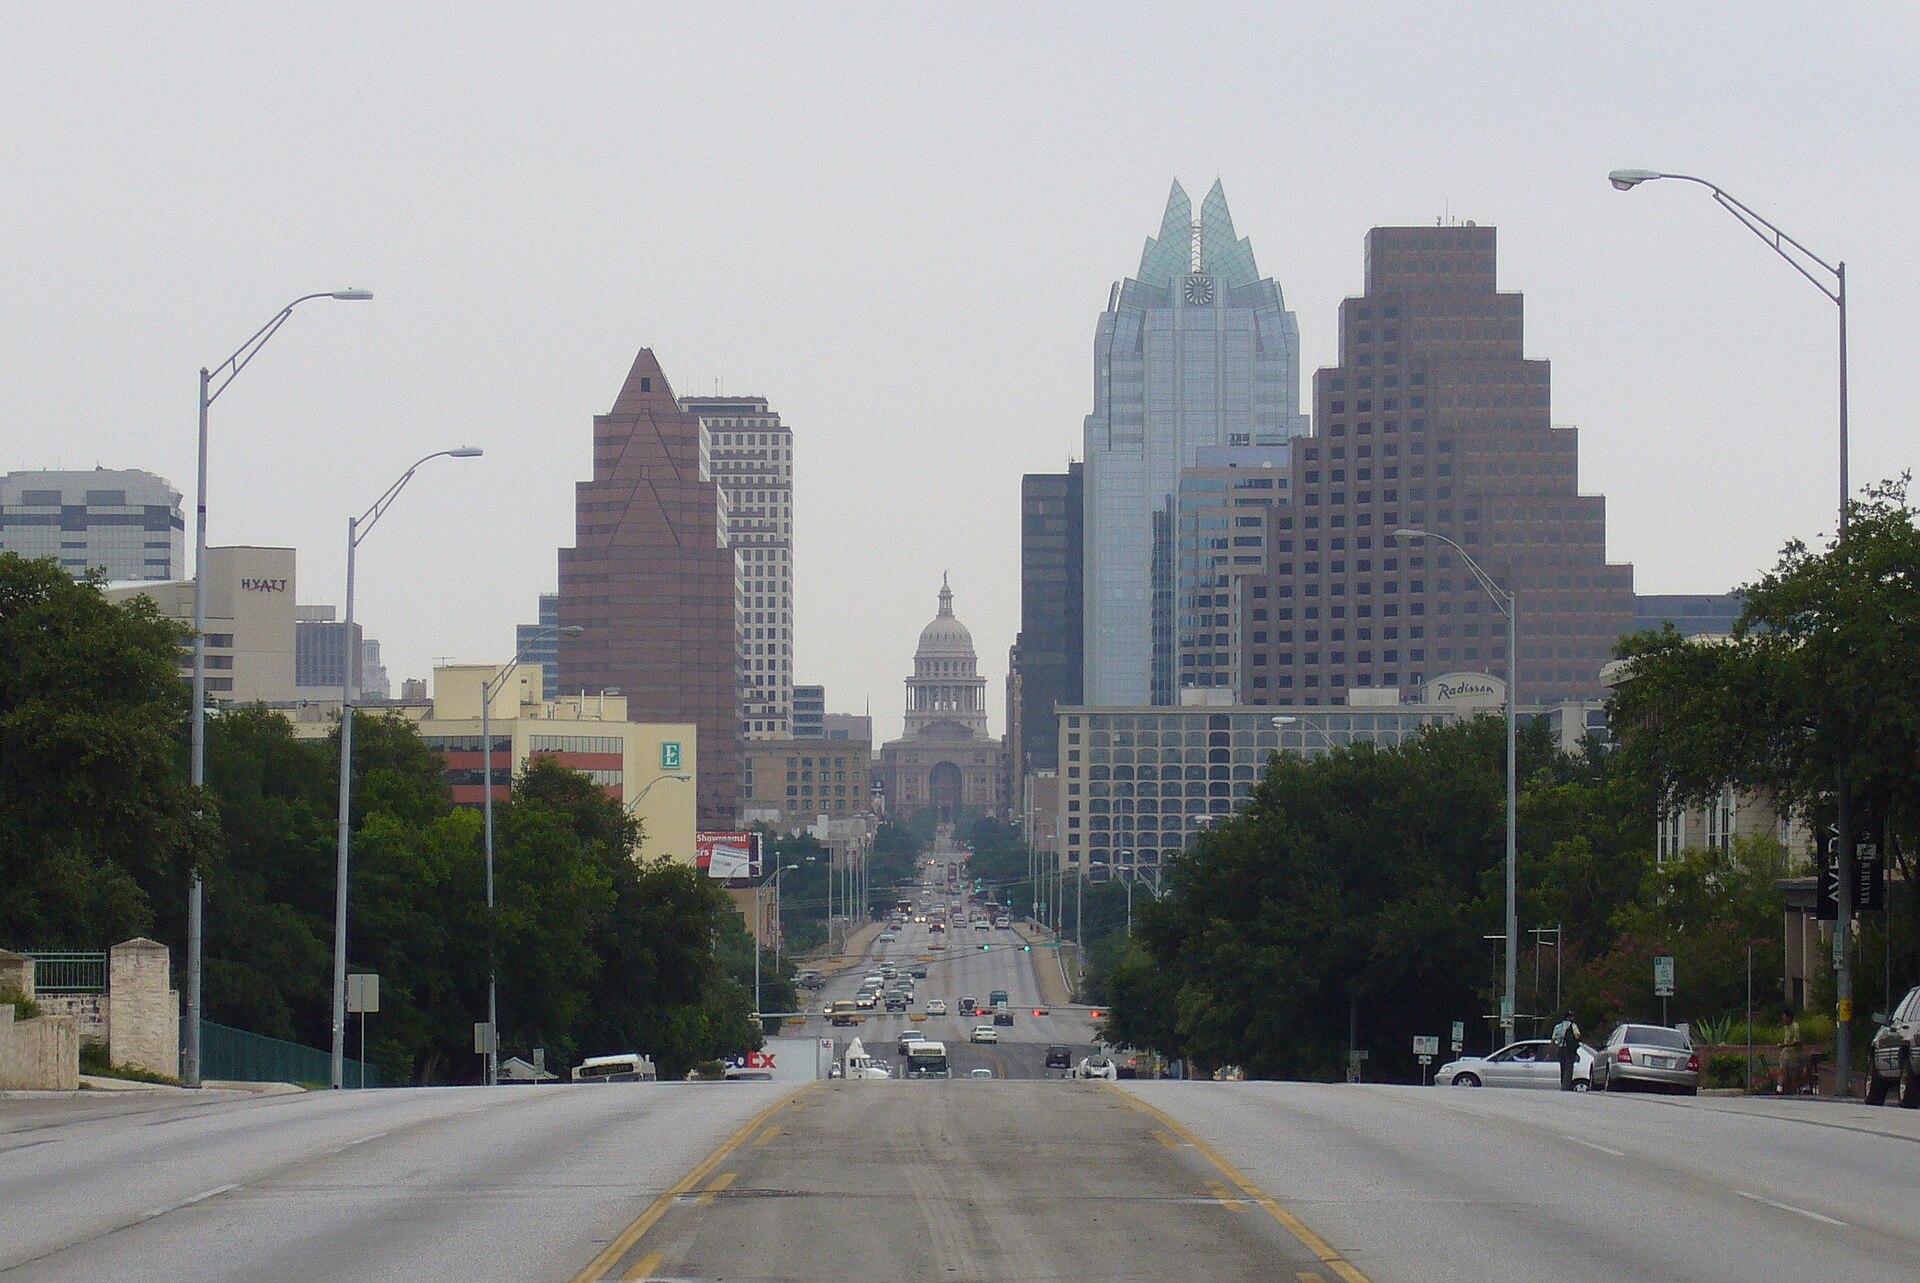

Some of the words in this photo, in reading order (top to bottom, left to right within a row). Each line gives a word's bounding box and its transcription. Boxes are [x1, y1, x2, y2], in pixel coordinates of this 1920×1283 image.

[241, 579, 287, 592] HYATT
[1438, 681, 1495, 700] Radisson
[665, 745, 677, 765] E
[725, 1051, 776, 1069] edEx
